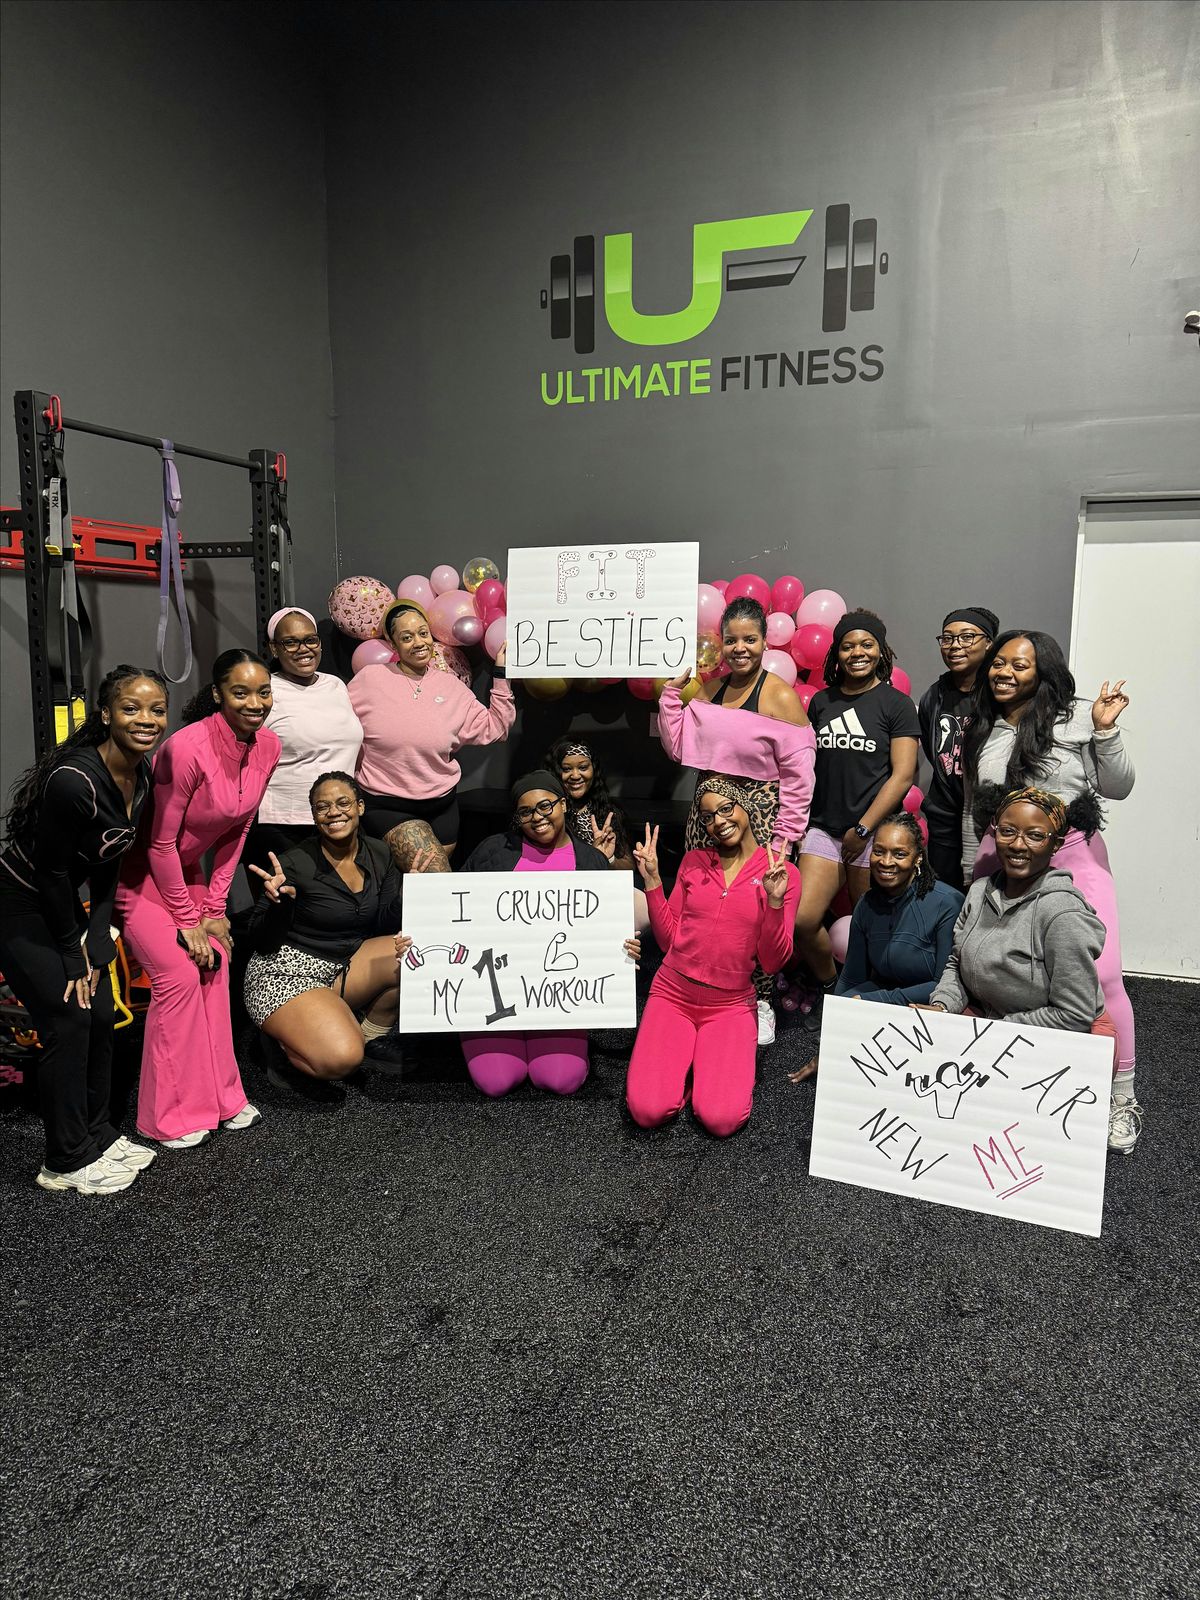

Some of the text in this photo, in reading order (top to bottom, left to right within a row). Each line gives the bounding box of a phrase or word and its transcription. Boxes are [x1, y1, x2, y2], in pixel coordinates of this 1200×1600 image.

[541, 344, 884, 406] ULTIMATE FITNESS
[51, 491, 59, 508] TRX
[557, 549, 656, 604] FIT
[511, 613, 686, 668] BESTIES
[451, 889, 599, 926] I CRUSHED
[433, 978, 463, 1025] MY
[520, 973, 615, 1013] WORKOUT
[850, 1008, 1098, 1140] NEW YEAR
[859, 1107, 1043, 1189] NEW ME
